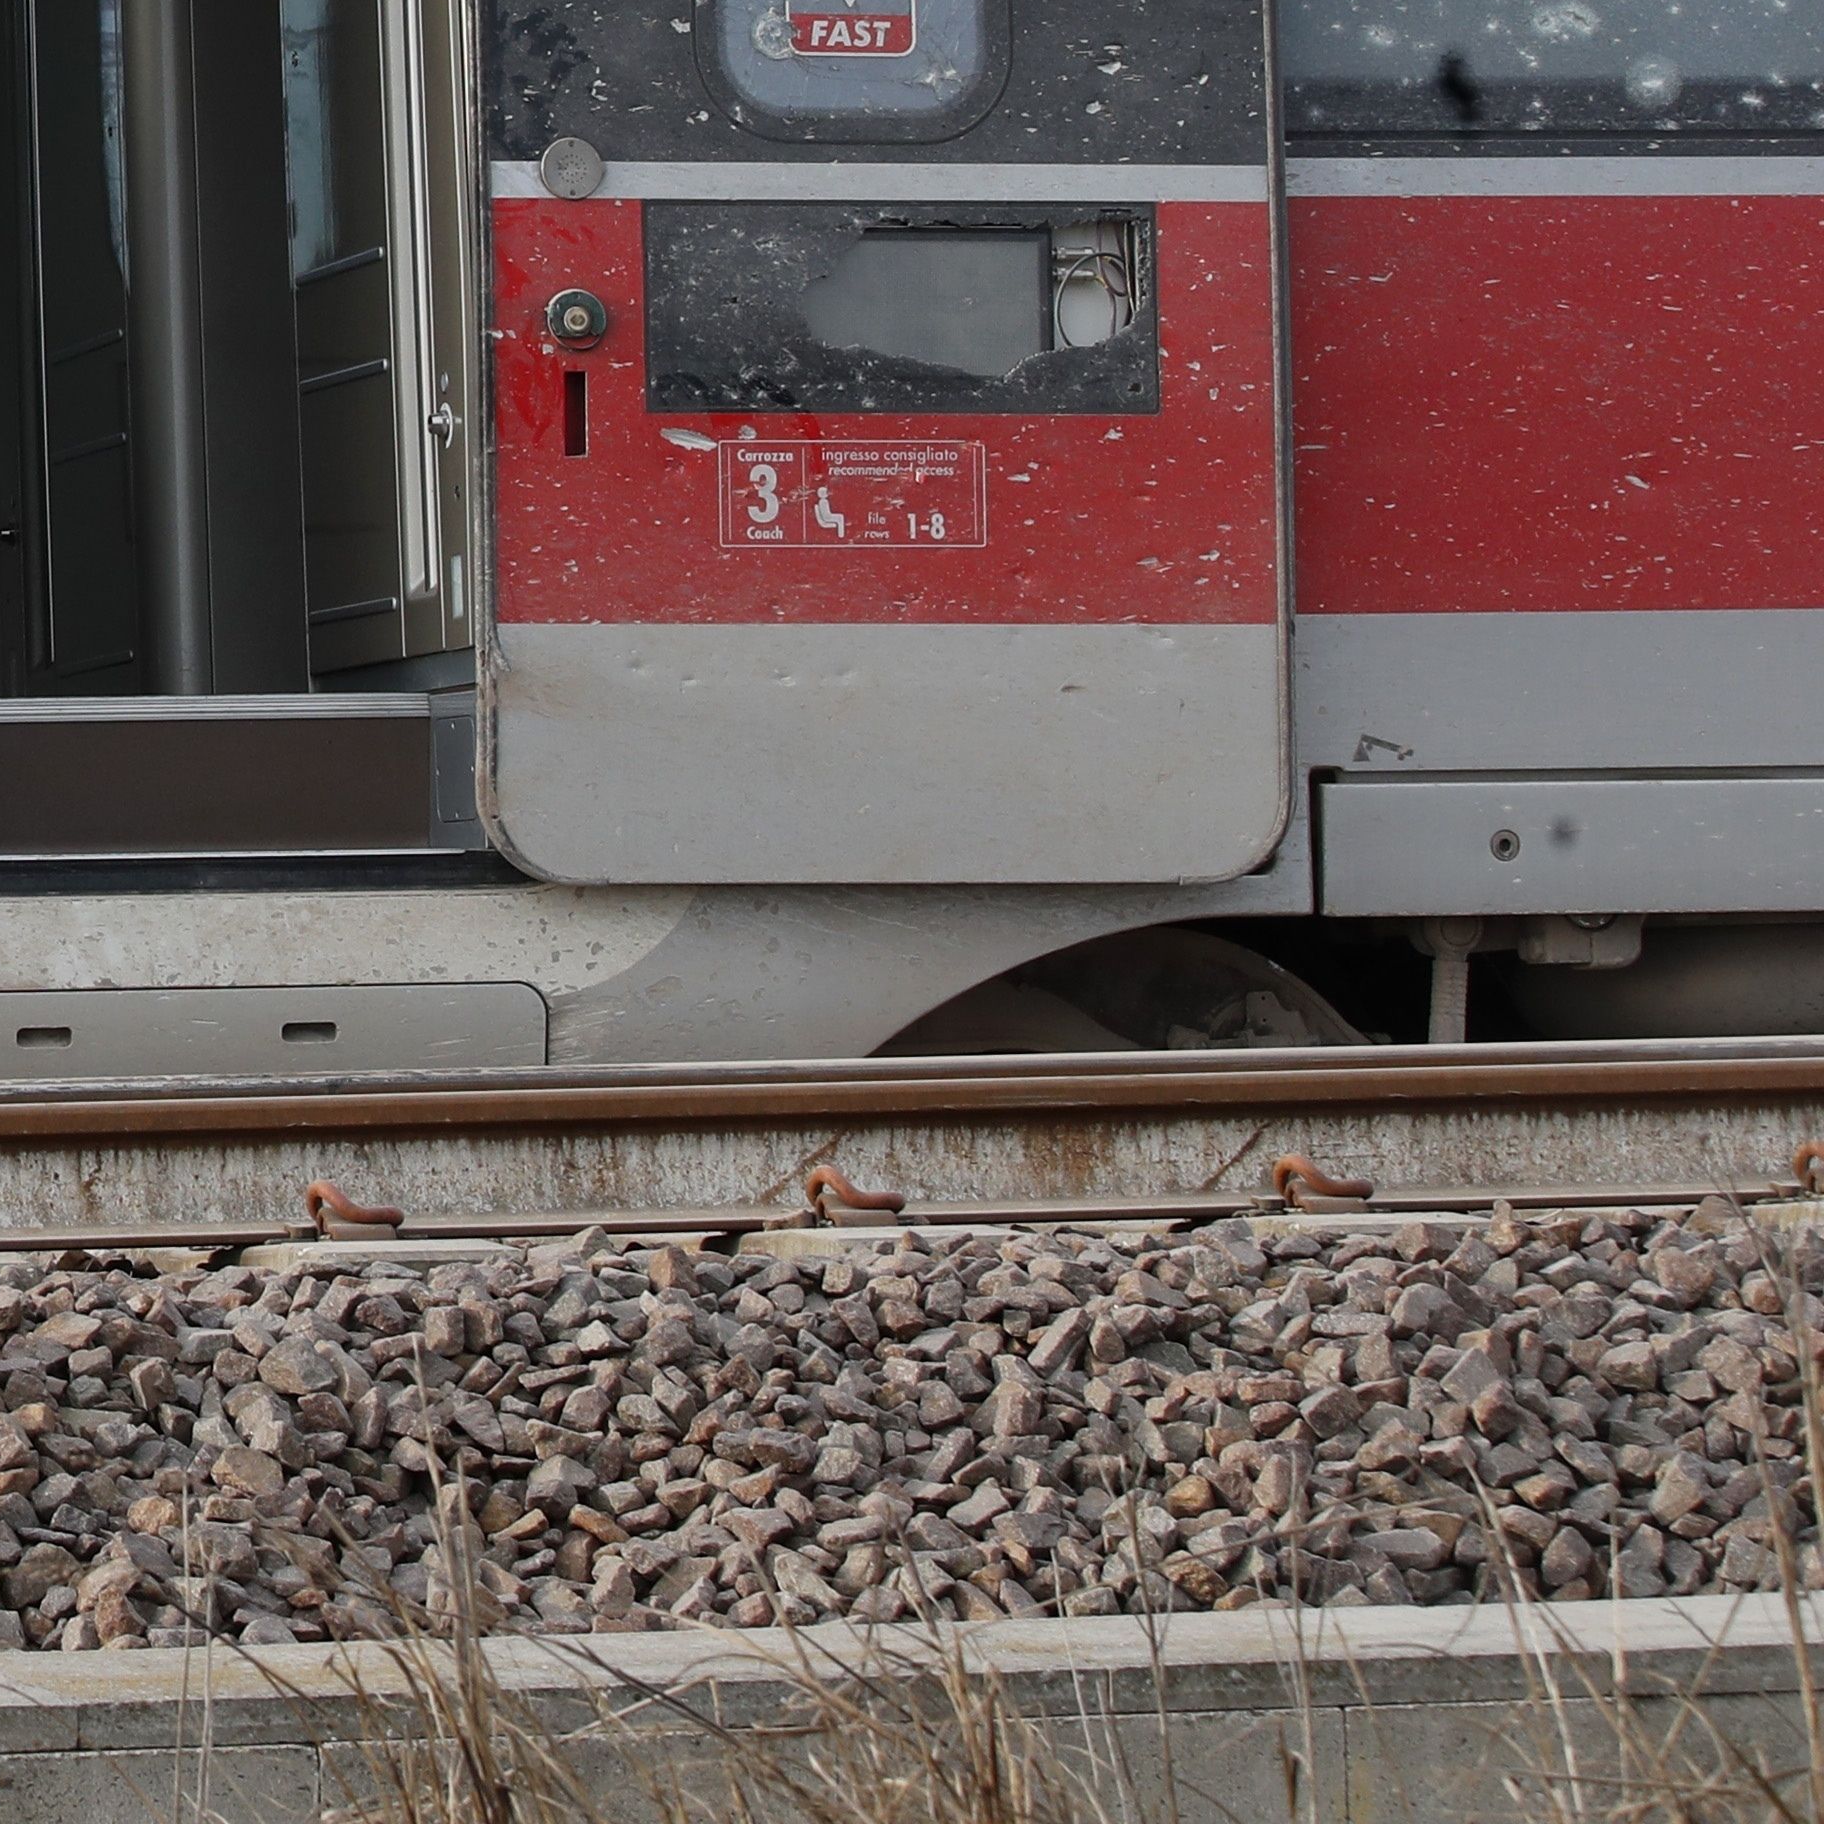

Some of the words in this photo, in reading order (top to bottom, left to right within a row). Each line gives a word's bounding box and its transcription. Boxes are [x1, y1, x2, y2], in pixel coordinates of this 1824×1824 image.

[810, 20, 892, 48] FAST
[736, 448, 794, 463] Carrozza
[821, 447, 880, 465] ingresso
[883, 446, 959, 466] consigliato
[915, 465, 954, 476] access
[747, 464, 779, 523] 3
[867, 511, 886, 524] file
[746, 526, 784, 540] Coach
[907, 513, 946, 539] 1-8
[864, 530, 890, 539] rows
